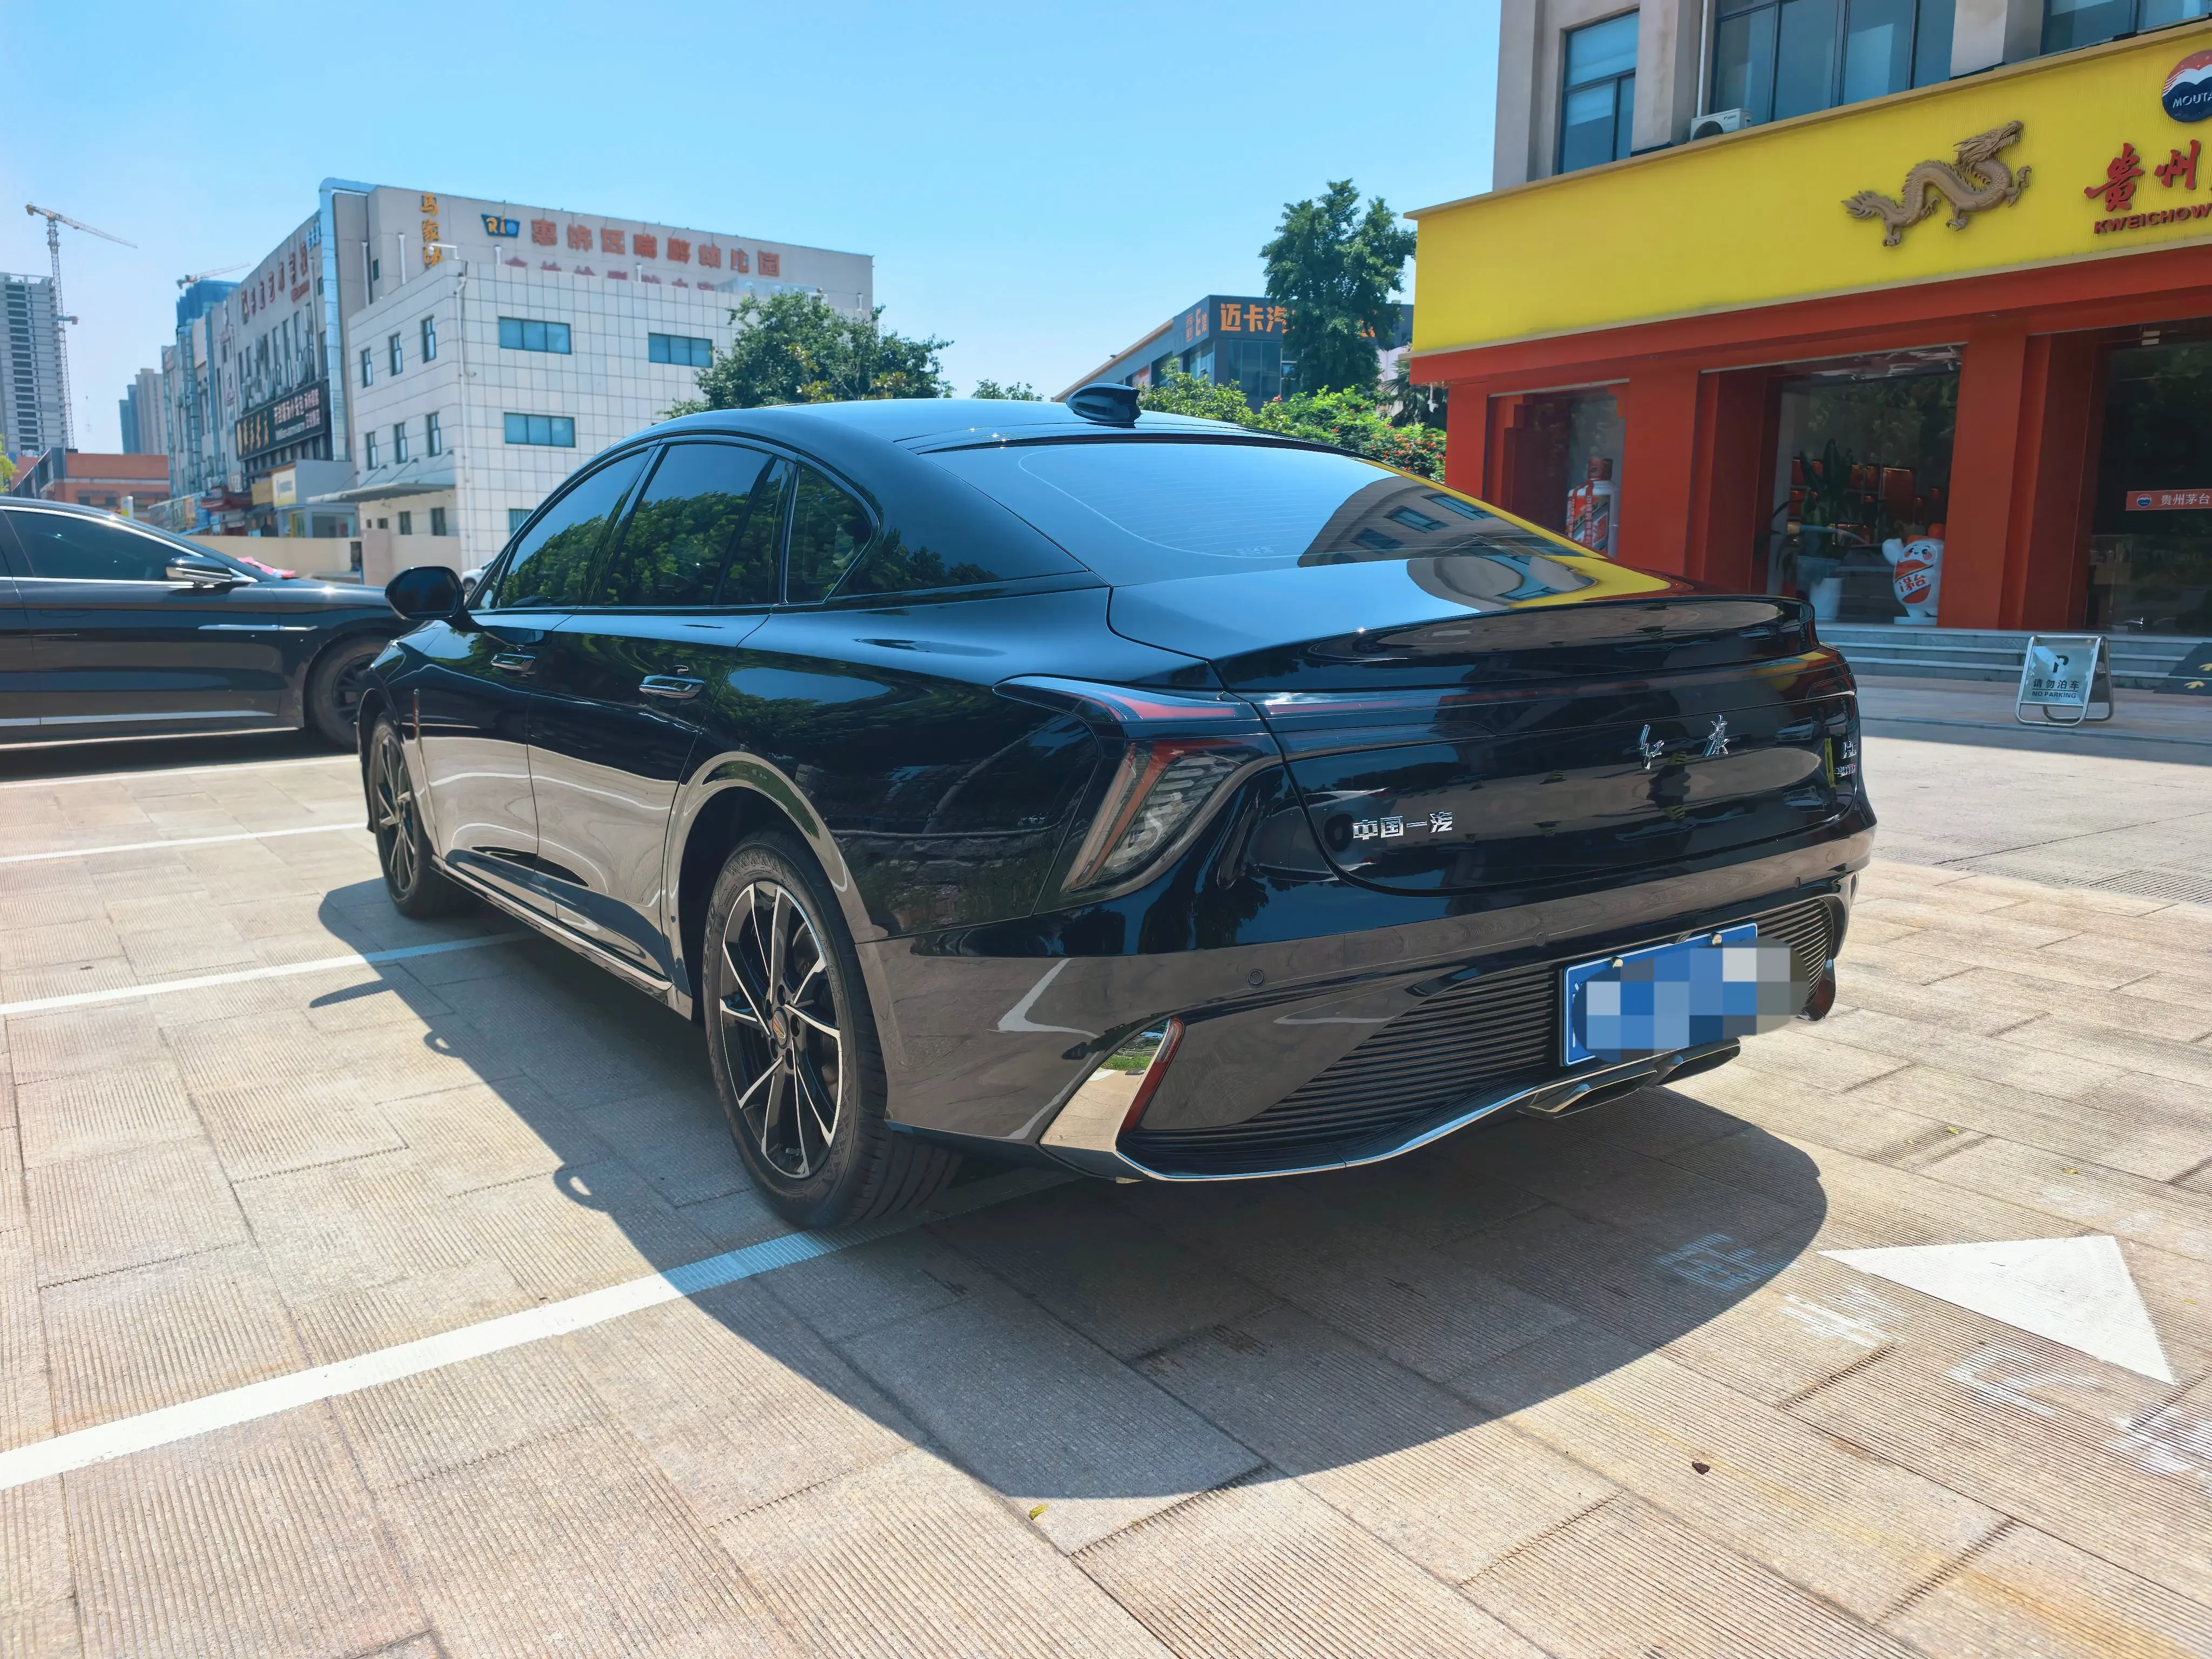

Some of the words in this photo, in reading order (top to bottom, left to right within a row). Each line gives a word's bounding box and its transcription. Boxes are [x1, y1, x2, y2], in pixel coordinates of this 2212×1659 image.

[2094, 203, 2212, 234] KWEICHOW
[1220, 303, 1296, 334] 迈卡汽
[2160, 493, 2210, 505] 贵州茅台
[2033, 679, 2080, 690] 请勿泊车
[1352, 811, 1453, 840] 中国一汽
